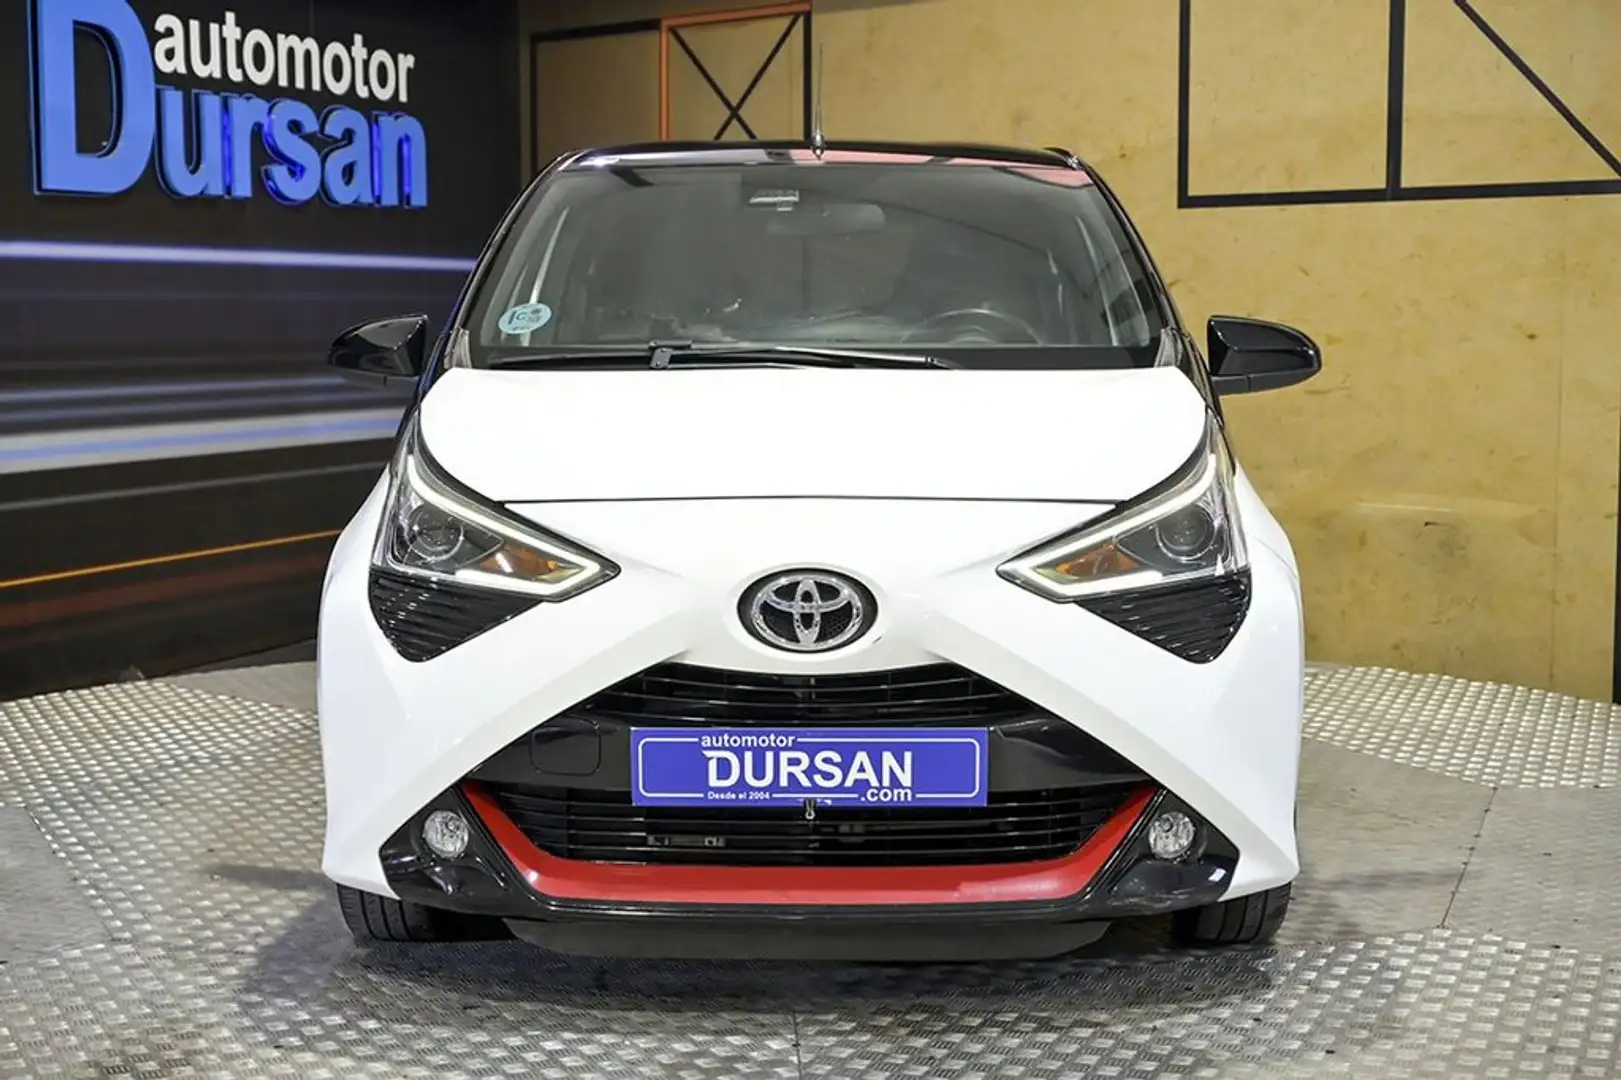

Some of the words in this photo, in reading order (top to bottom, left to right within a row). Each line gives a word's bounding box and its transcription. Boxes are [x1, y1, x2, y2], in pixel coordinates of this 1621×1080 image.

[154, 11, 415, 103] automotor
[27, 0, 428, 209] Dursan
[701, 733, 796, 747] automotor
[702, 750, 913, 788] DURSAN
[707, 791, 737, 800] Desde
[738, 791, 747, 800] el
[748, 791, 770, 800] 2004
[860, 787, 912, 802] .com
